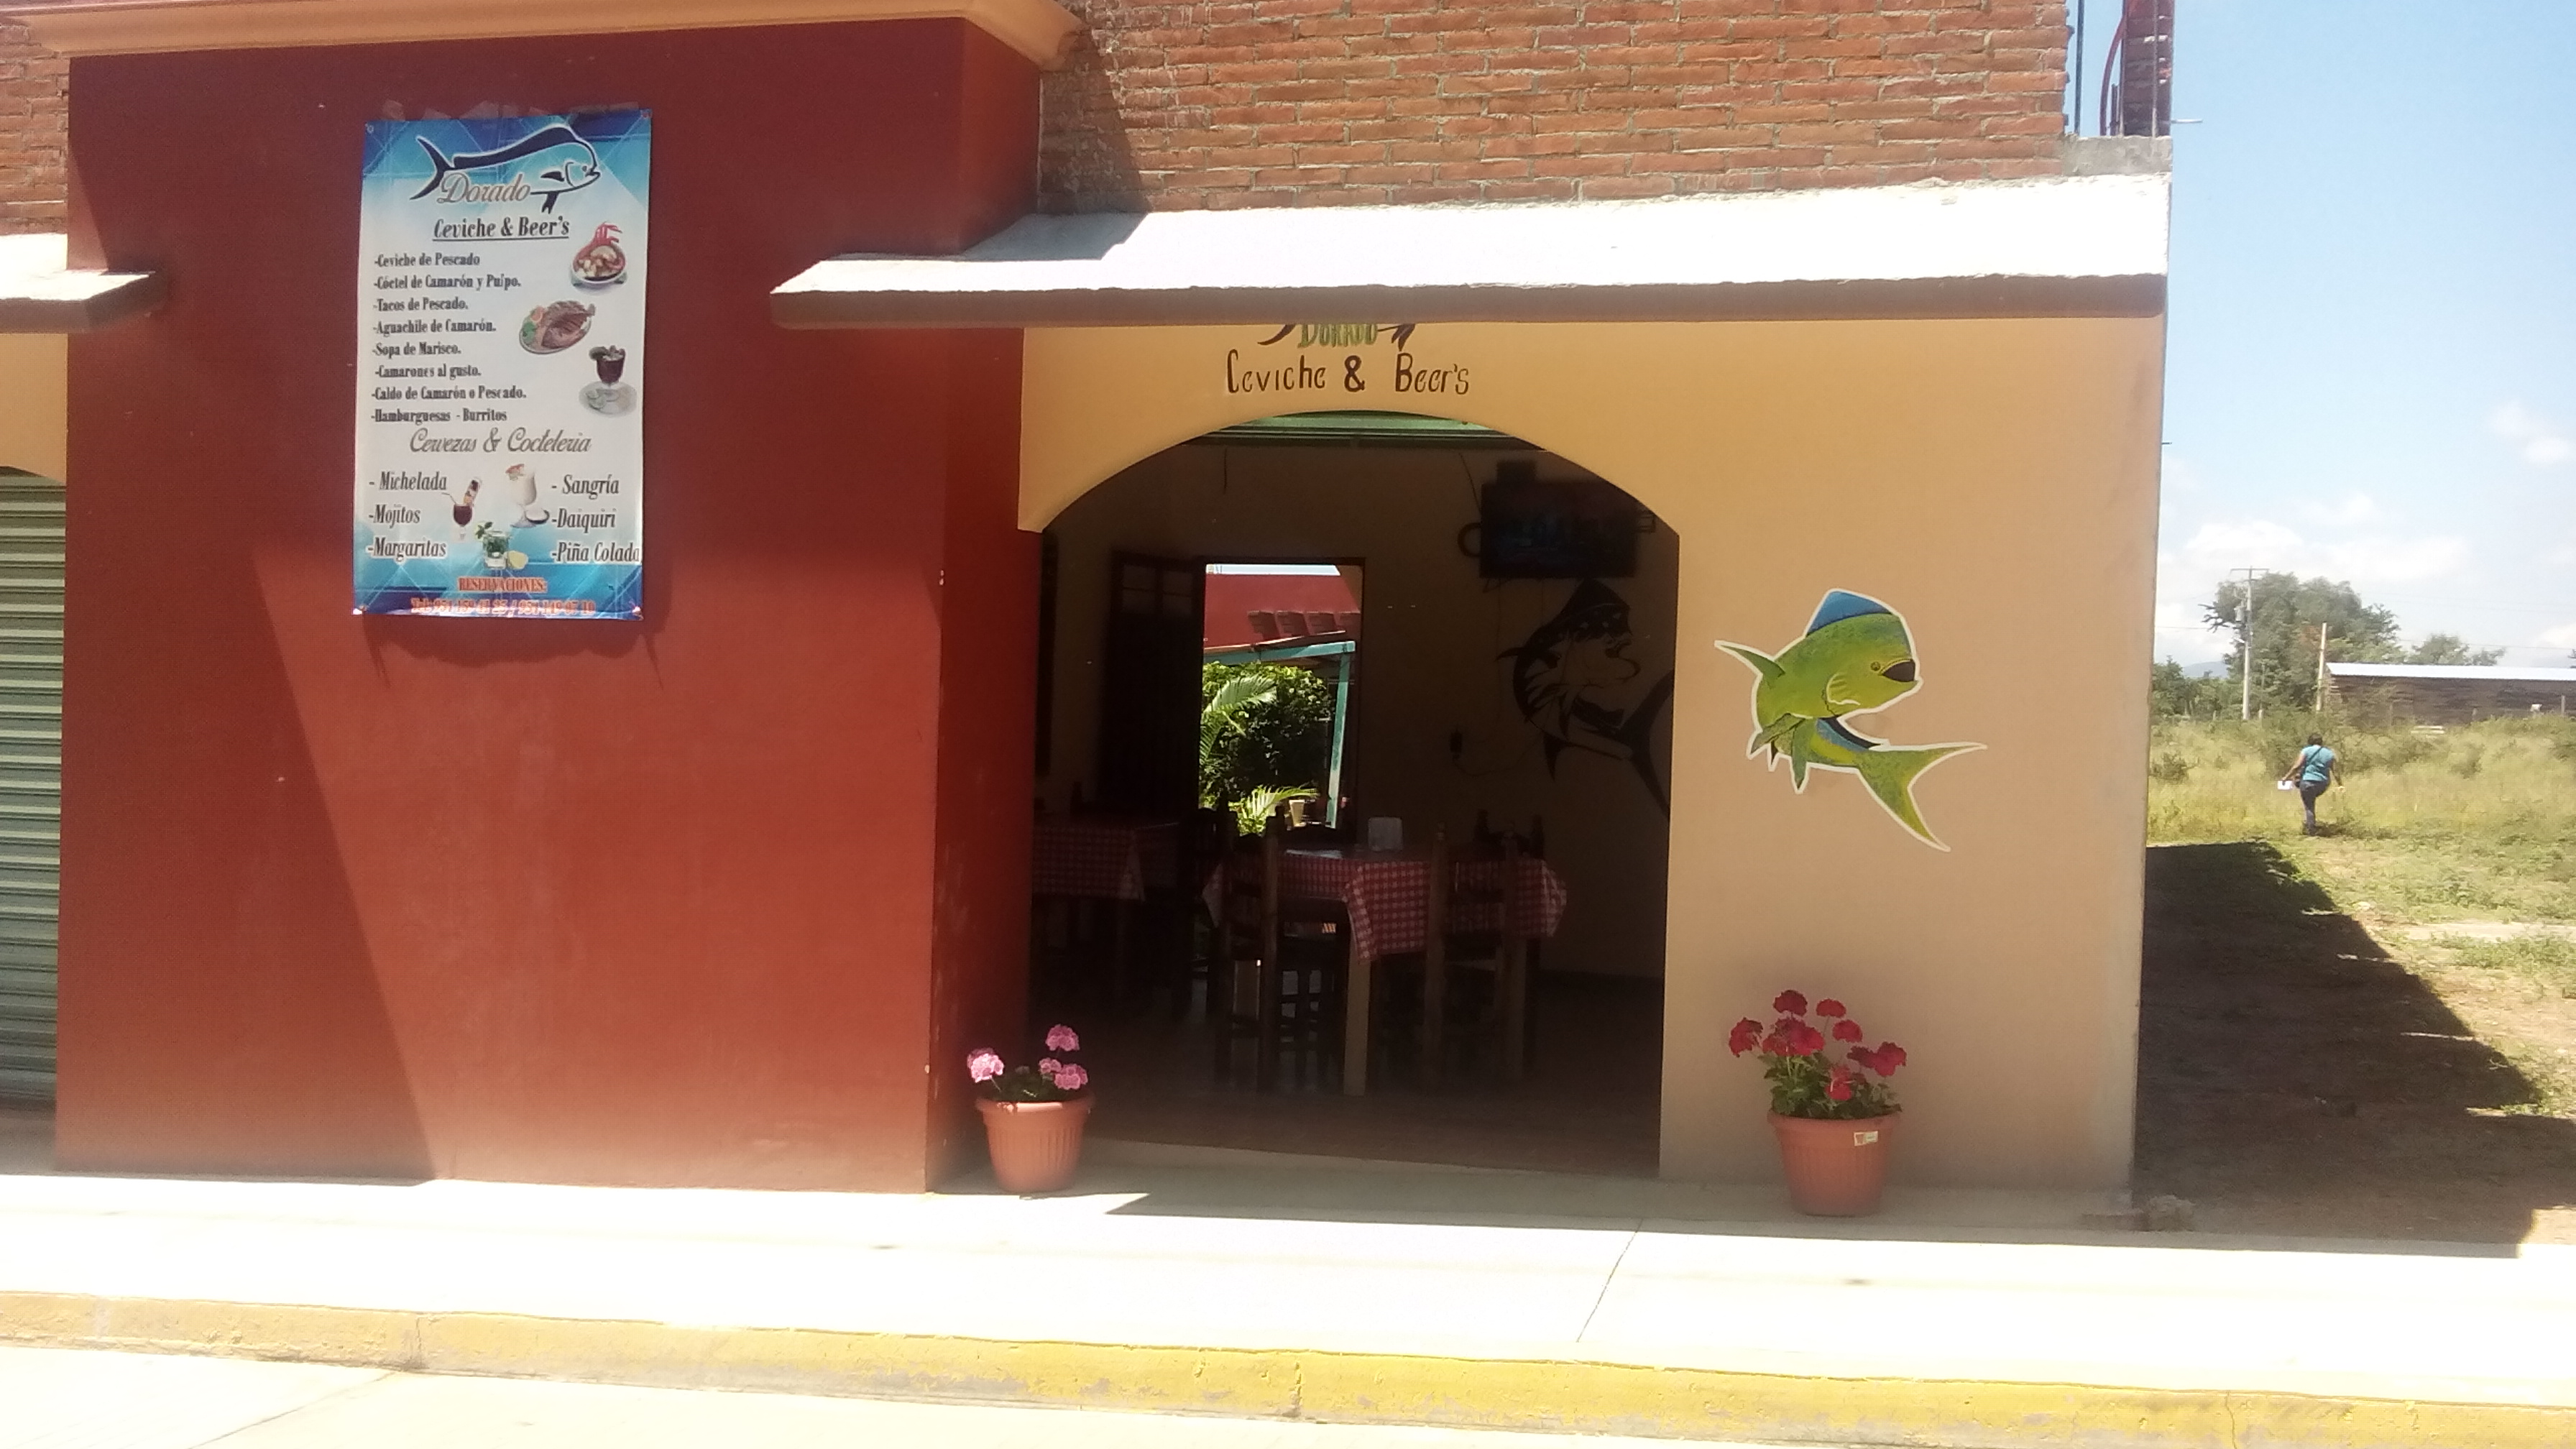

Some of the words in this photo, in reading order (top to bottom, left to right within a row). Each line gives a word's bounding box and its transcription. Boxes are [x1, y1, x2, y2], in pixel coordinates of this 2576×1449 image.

[436, 172, 530, 203] Dorado
[433, 218, 496, 239] Ceviche
[501, 217, 513, 236] &
[518, 216, 569, 236] Beer's
[419, 252, 431, 266] de
[435, 252, 480, 266] Pescado
[410, 275, 423, 288] de
[426, 274, 472, 288] Camarón
[477, 277, 482, 291] y
[408, 298, 420, 310] de
[423, 299, 468, 310] Pescado.
[431, 320, 442, 333] de
[403, 342, 415, 355] de
[438, 364, 446, 377] al
[449, 365, 482, 380] gusto.
[1227, 349, 1326, 393] Ceviche
[1344, 356, 1365, 392] &
[1395, 353, 1469, 395] Beer's
[405, 386, 418, 400] de
[420, 386, 466, 400] Camarón
[469, 390, 474, 399] o
[478, 385, 526, 399] Pescado.
[463, 409, 507, 422] Burritos
[410, 428, 477, 453] Cervezas
[483, 428, 502, 452] &
[379, 472, 447, 490] Michelada
[562, 474, 620, 499] Sangría
[594, 542, 640, 562] Colada
